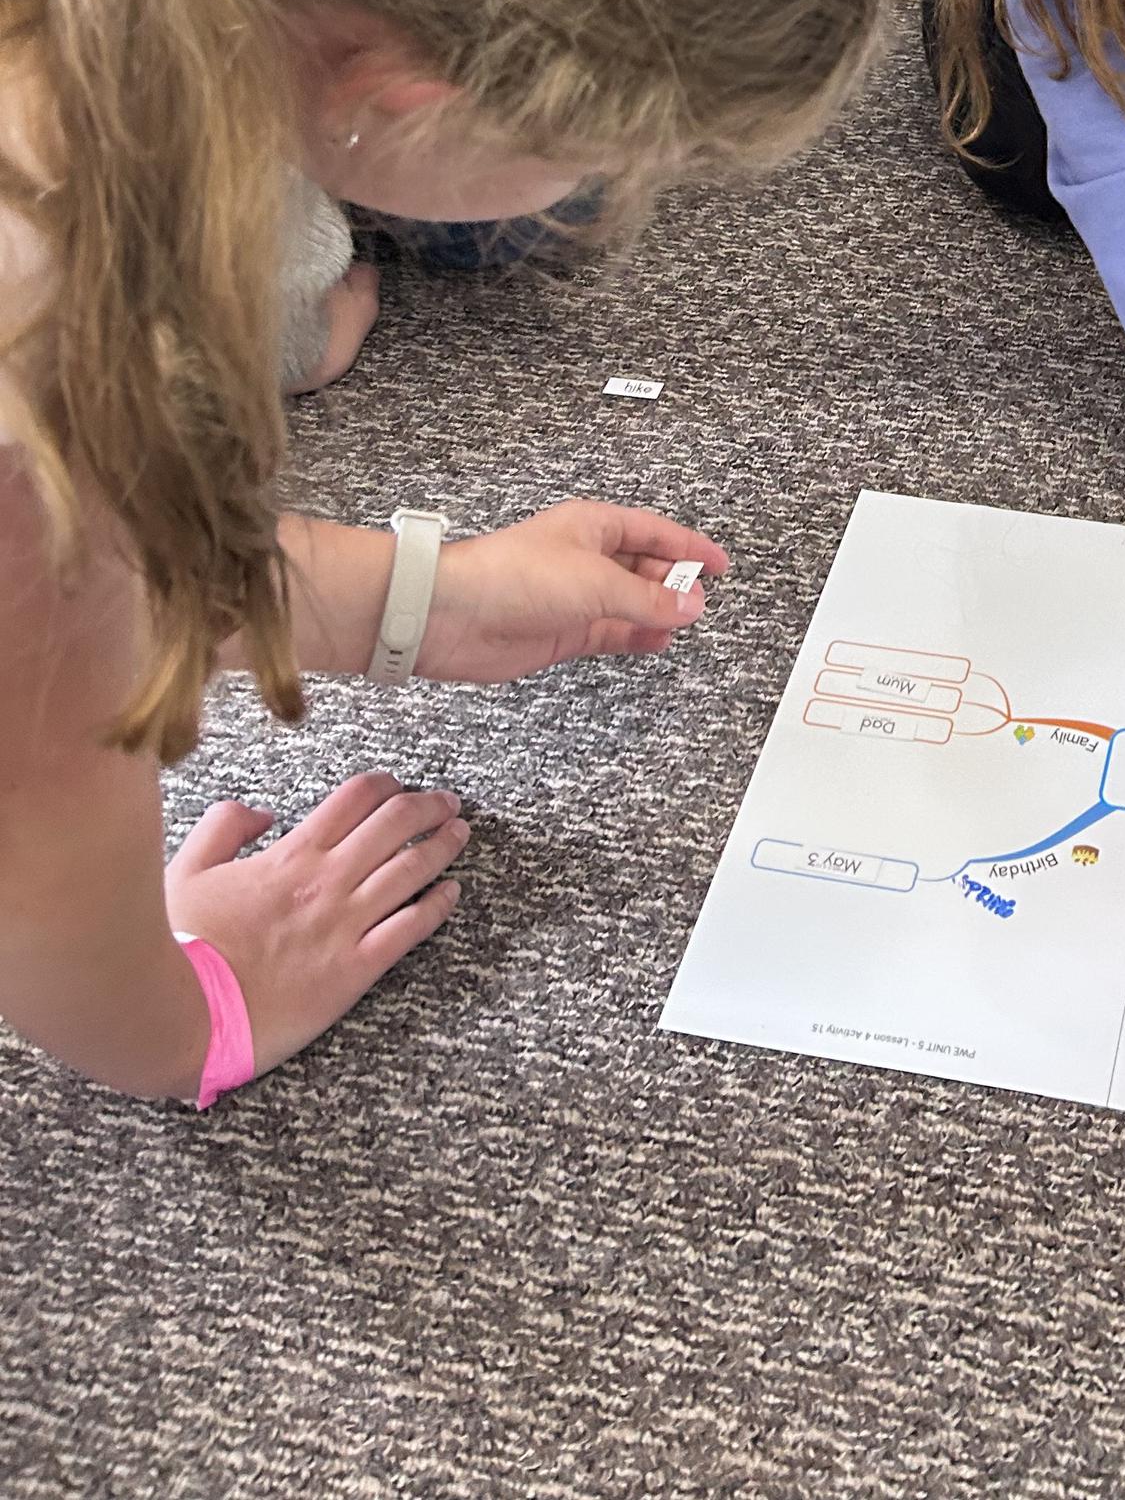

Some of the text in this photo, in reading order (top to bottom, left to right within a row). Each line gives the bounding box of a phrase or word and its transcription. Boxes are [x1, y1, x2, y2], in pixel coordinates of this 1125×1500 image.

[623, 381, 653, 394] hike
[876, 674, 917, 696] Mum
[859, 715, 896, 735] Dad
[1050, 726, 1100, 752] Family
[808, 851, 863, 876] May 3
[988, 851, 1060, 880] Birthday
[811, 1023, 823, 1034] 15
[826, 1023, 862, 1040] Activity
[865, 1032, 871, 1041] 4
[874, 1032, 909, 1047] Lesson
[918, 1040, 925, 1050] 5
[926, 1042, 951, 1055] UNIT
[953, 1046, 976, 1060] PWE
